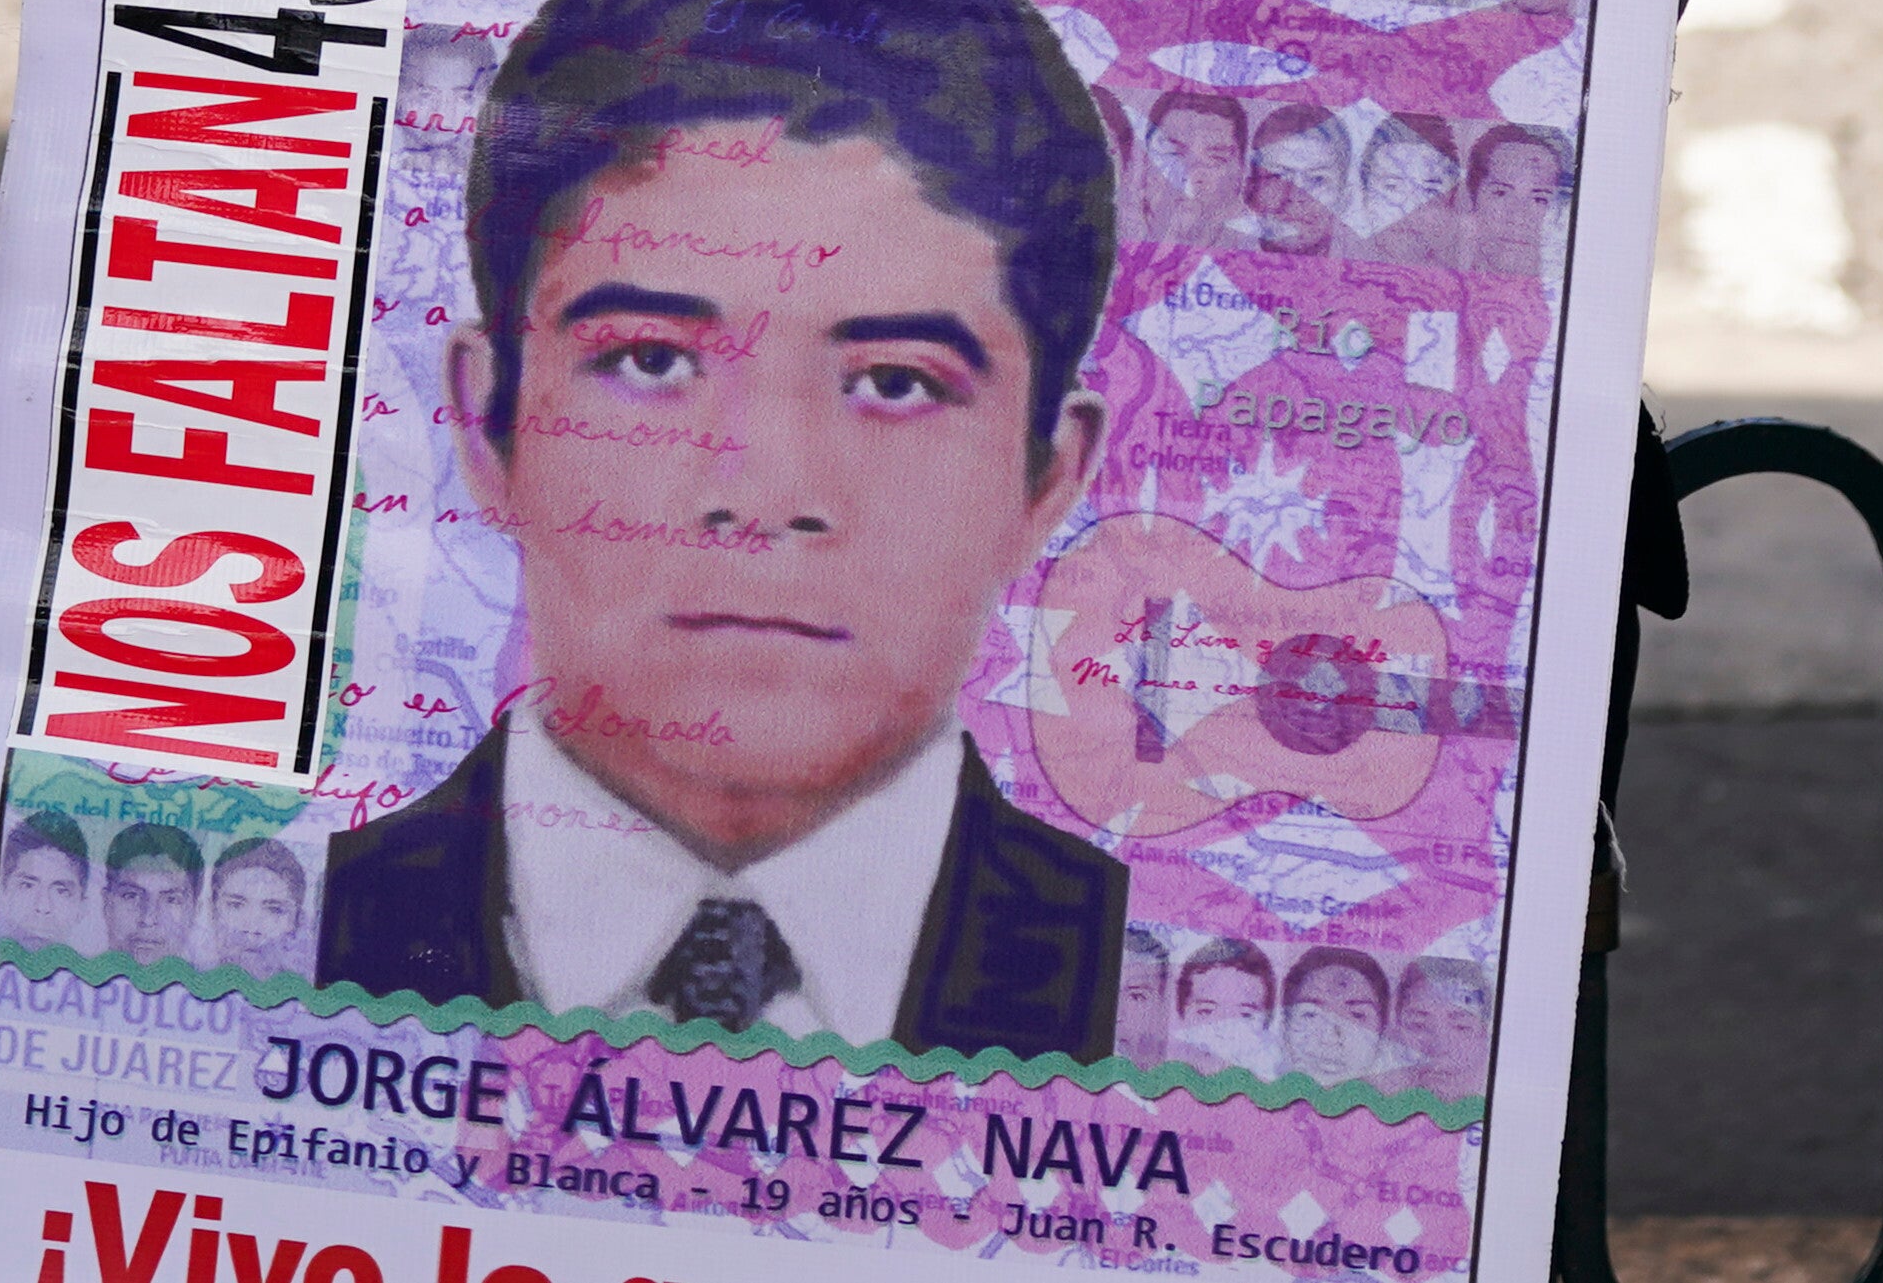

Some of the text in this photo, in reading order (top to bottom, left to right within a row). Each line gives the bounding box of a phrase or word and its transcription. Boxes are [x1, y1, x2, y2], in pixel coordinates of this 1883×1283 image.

[85, 70, 357, 496] FALTAN
[1272, 307, 1375, 360] Río
[1194, 379, 1470, 456] Papagayo
[44, 520, 306, 768] NOS
[60, 1028, 239, 1092] JUÁREZ
[261, 1034, 508, 1128] JORGE
[560, 1057, 928, 1171] ÁLVAREZ
[982, 1113, 1192, 1196] NAVA
[24, 1094, 126, 1144] Hijo
[151, 1108, 201, 1146] de
[228, 1118, 431, 1177] Epifanio
[454, 1150, 482, 1190] y
[505, 1152, 660, 1200] Blanca
[739, 1175, 792, 1213] 19
[818, 1185, 921, 1228] años
[1001, 1203, 1105, 1244] Juan
[1133, 1214, 1178, 1253] R.
[1210, 1223, 1421, 1276] Escudero
